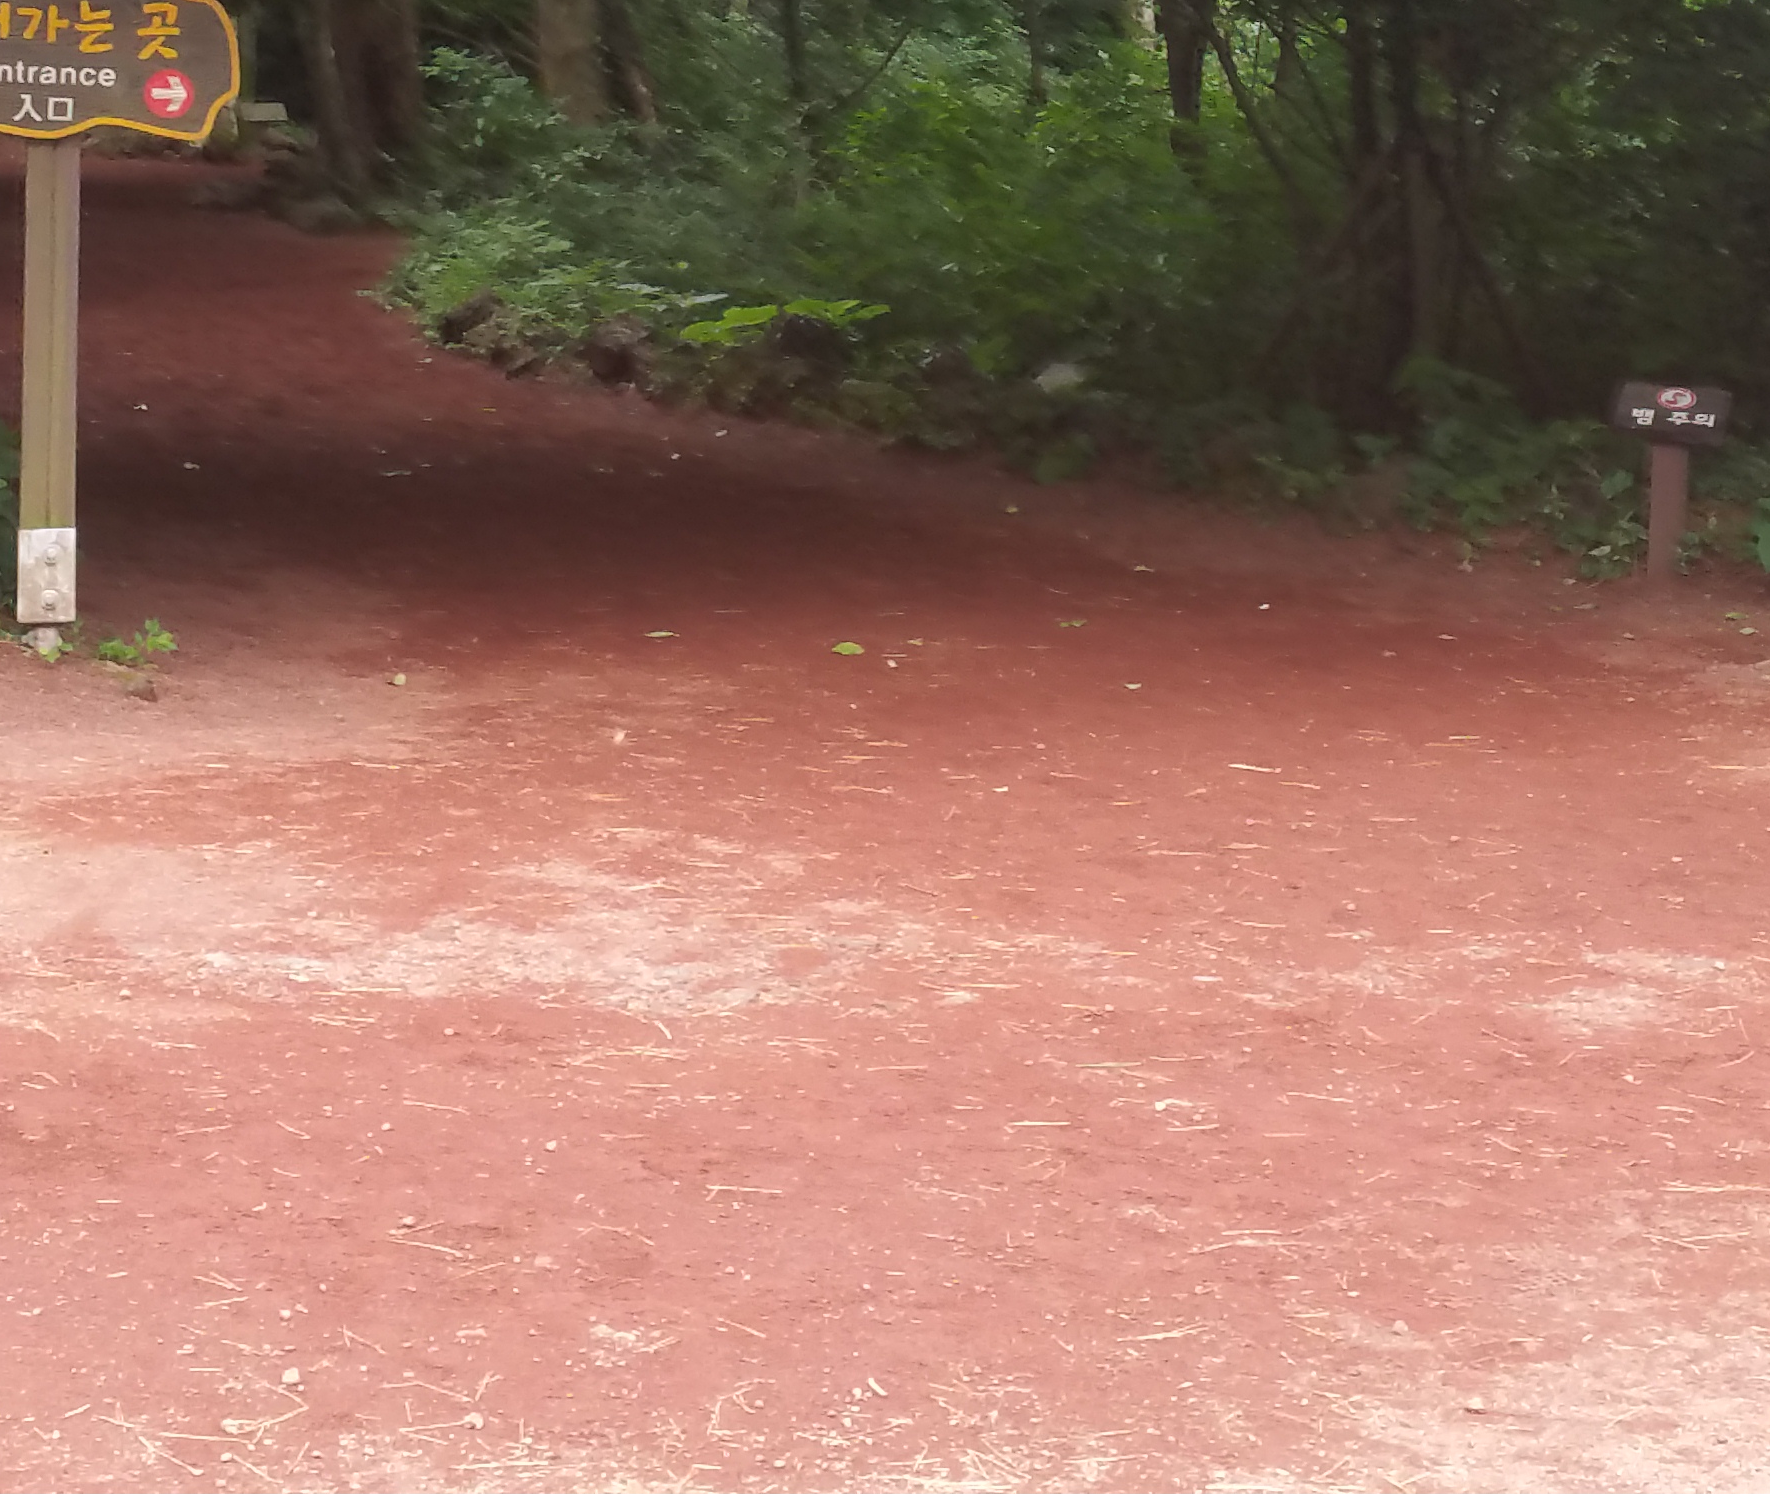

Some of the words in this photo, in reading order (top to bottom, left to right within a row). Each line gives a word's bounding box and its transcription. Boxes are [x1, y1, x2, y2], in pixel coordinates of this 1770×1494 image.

[135, 1, 182, 61] 곳
[12, 94, 73, 121] 入口
[1631, 408, 1654, 425] 뱀
[1666, 412, 1715, 427] 주의
